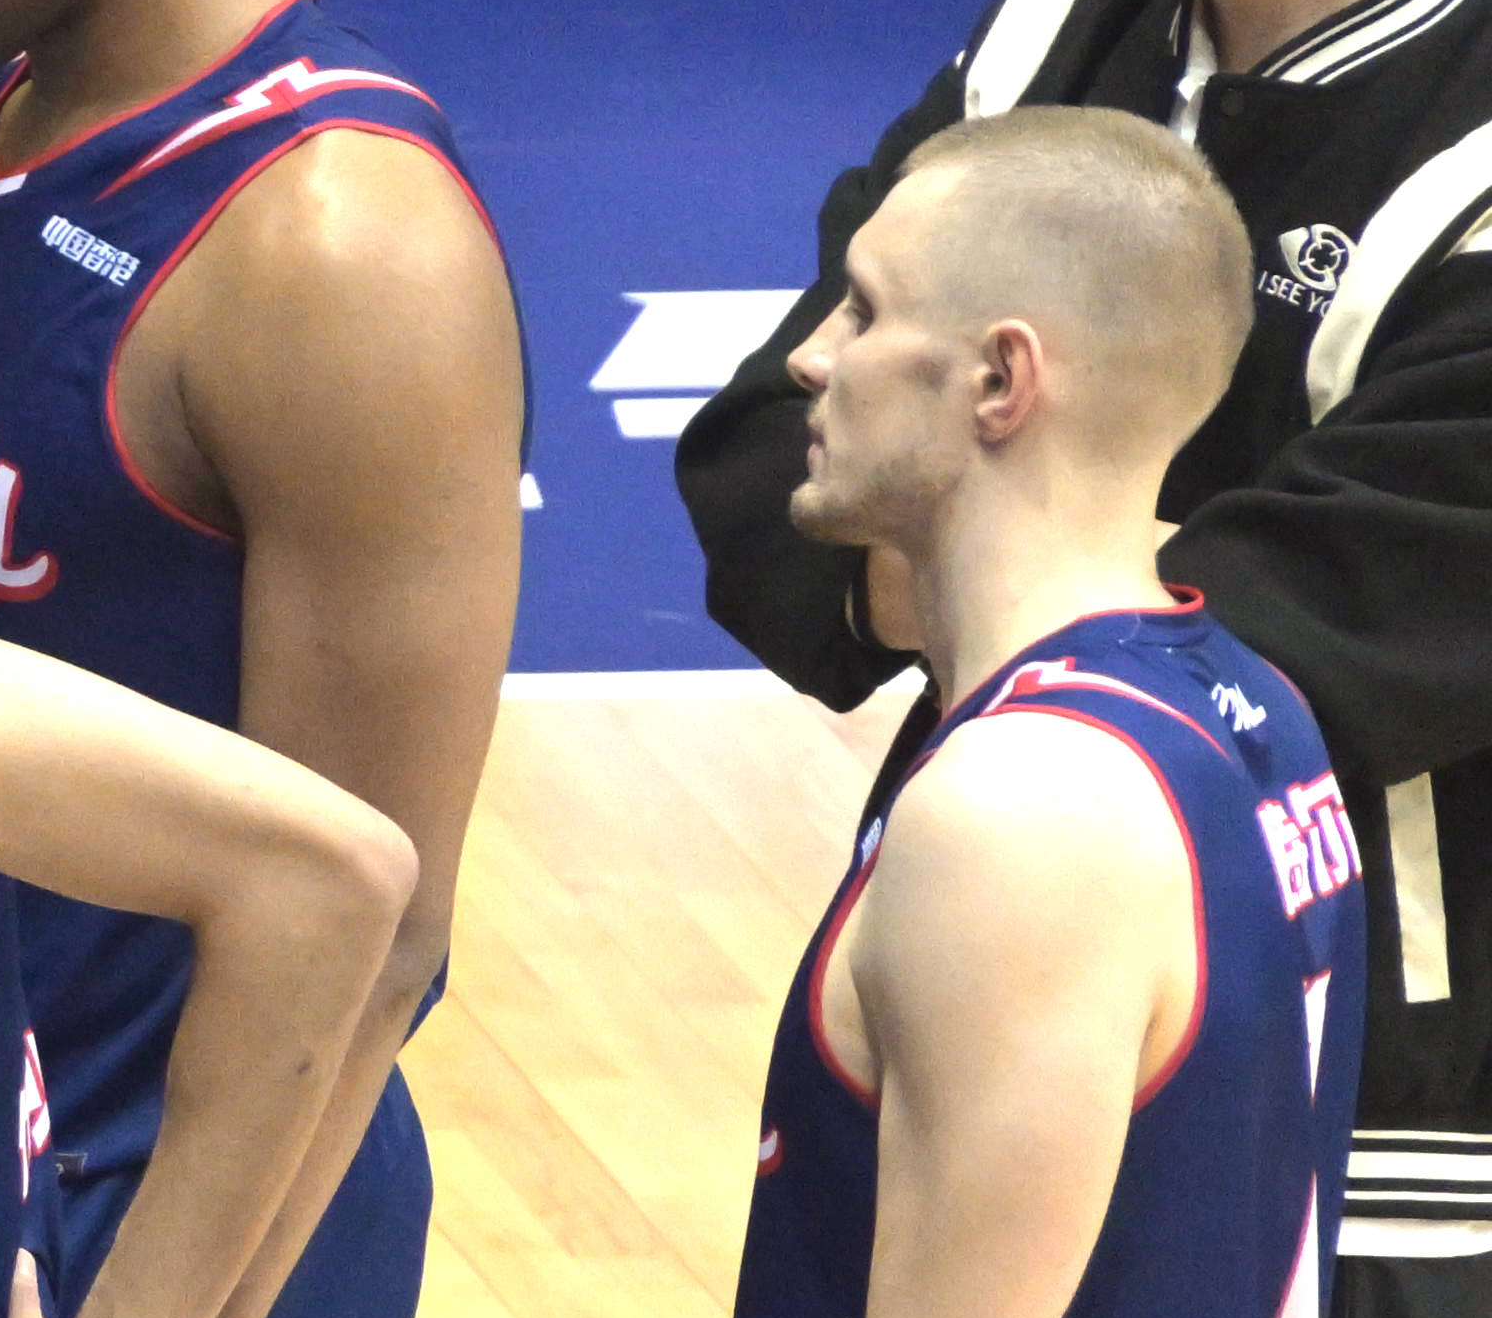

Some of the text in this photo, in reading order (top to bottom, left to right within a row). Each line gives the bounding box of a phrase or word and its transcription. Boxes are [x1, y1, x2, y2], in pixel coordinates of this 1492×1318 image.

[41, 214, 141, 287] 中国香港
[1266, 274, 1307, 306] SEE
